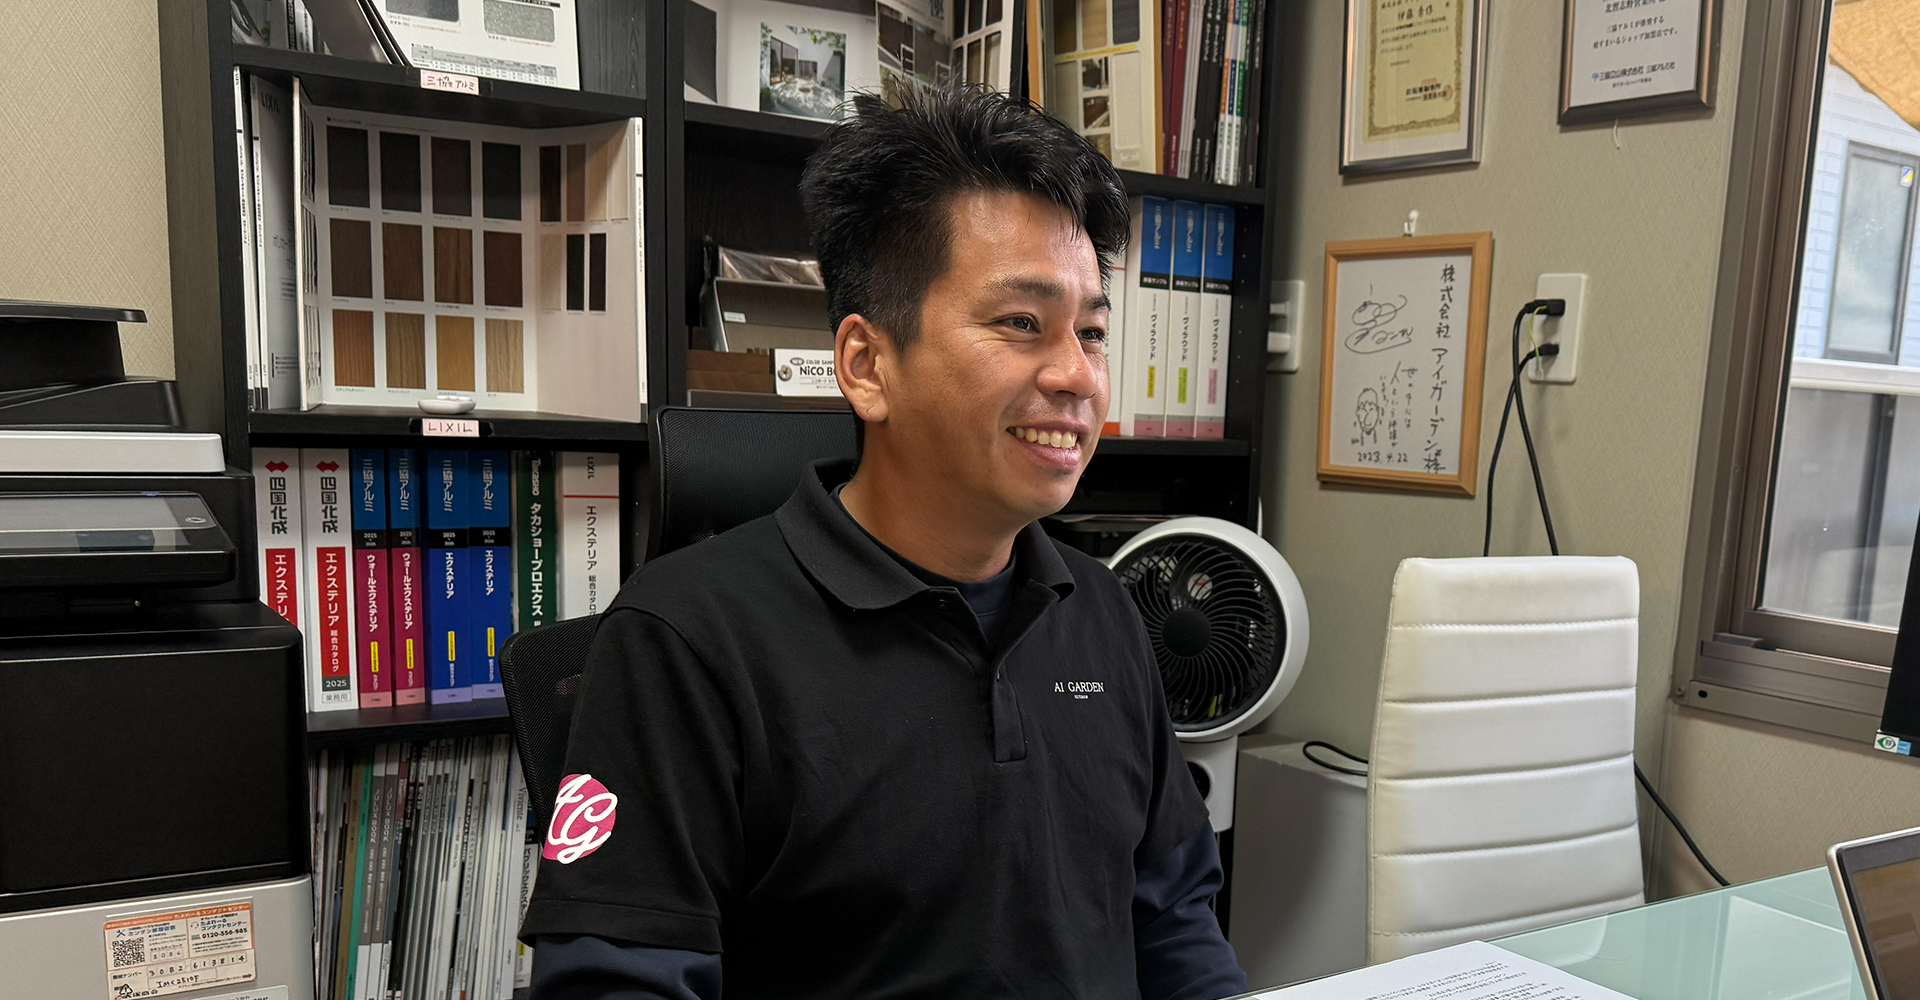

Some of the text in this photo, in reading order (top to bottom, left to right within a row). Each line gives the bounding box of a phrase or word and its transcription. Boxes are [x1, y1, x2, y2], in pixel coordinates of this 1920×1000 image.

[1437, 263, 1456, 339] 株式会社
[428, 422, 473, 433] LIXIL
[269, 477, 288, 535] 四国化成
[320, 477, 338, 533] 四国化成
[363, 458, 375, 512] 三協アルミ
[399, 458, 410, 511] 三協アルミ
[443, 459, 454, 512] 三協アルミ
[482, 459, 494, 510] 三協アルミ
[586, 505, 598, 570] エクステリア
[275, 554, 289, 621] エクステリ
[366, 554, 378, 632] ウォールエクステリア
[402, 552, 413, 630] ウォールエクステリア
[445, 552, 455, 599] エクステリア
[485, 550, 495, 596] エクステリア
[326, 553, 340, 673] エクステリア 総合カタログ
[326, 680, 347, 688] 2025
[1054, 682, 1104, 692] AI GARDEN
